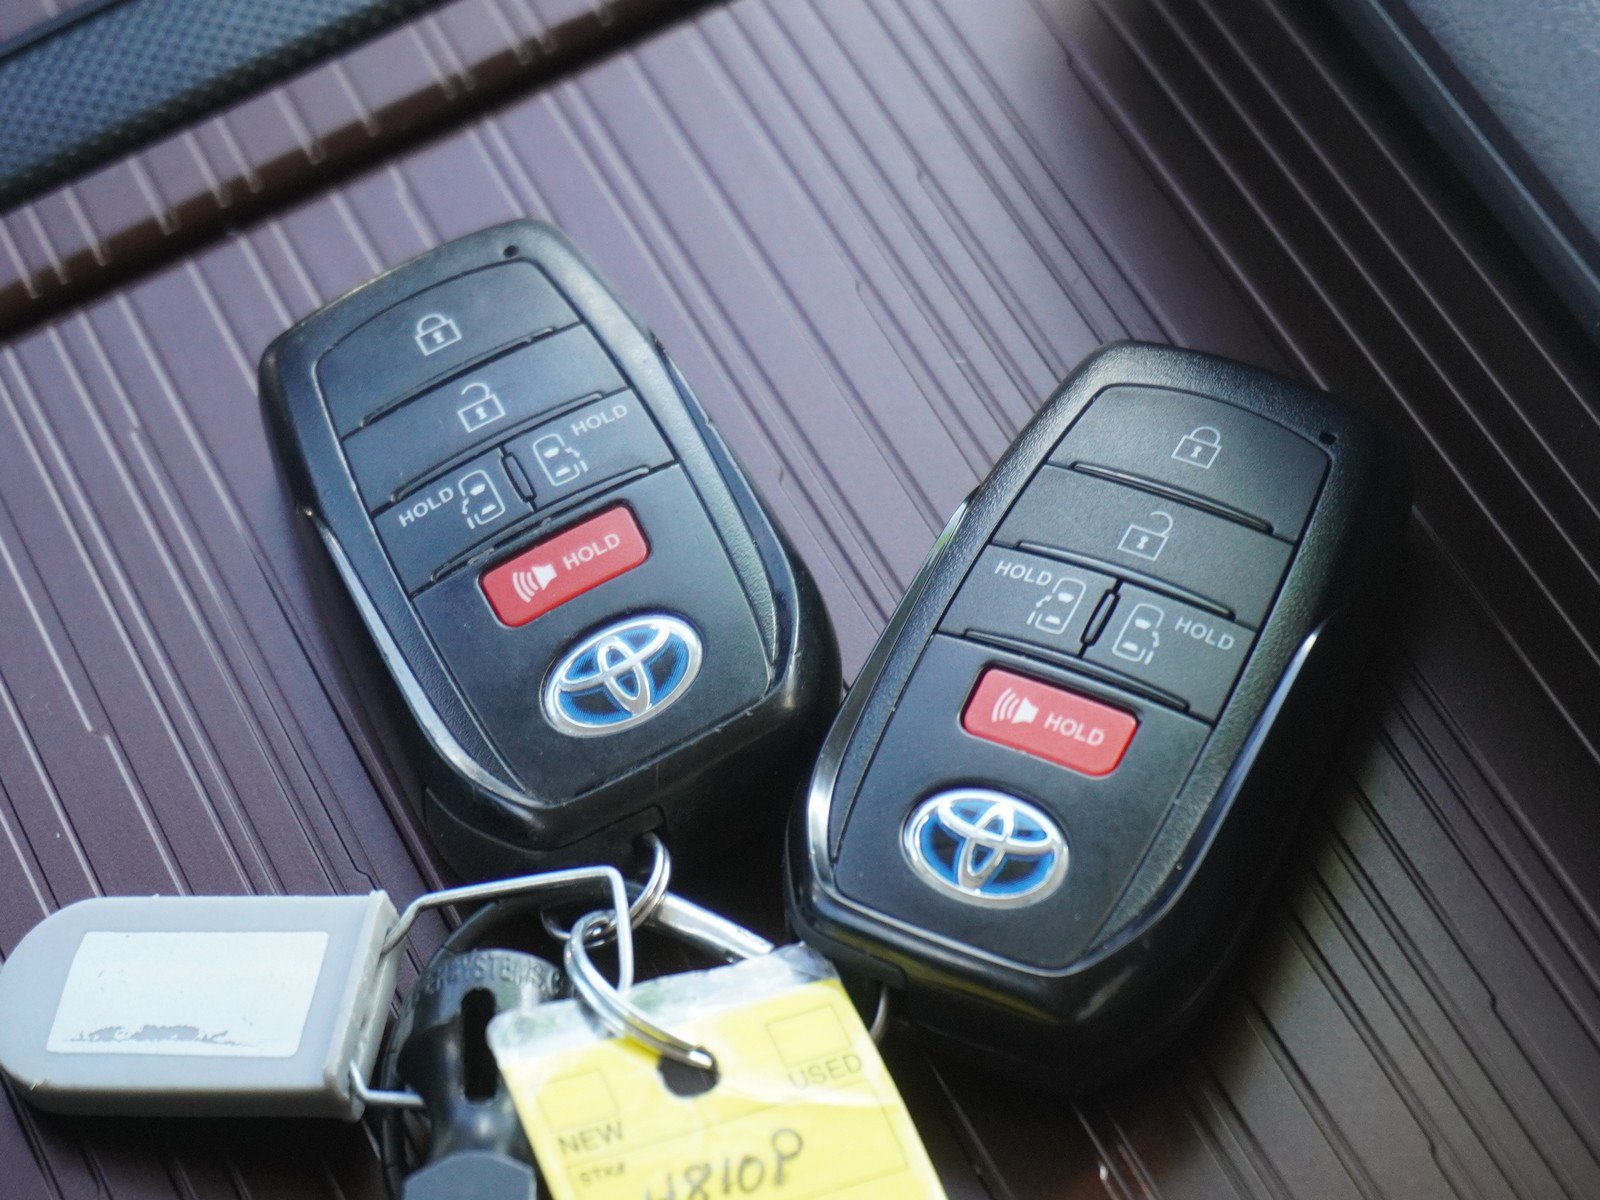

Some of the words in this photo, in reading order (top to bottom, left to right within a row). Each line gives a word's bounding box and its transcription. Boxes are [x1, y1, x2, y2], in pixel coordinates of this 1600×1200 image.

[571, 404, 628, 436] HOLD
[398, 486, 455, 528] HOLD
[562, 532, 621, 571] HOLD
[994, 559, 1052, 587] HOLD
[1174, 616, 1235, 651] HOLD
[1043, 713, 1105, 747] HOLD
[787, 1054, 863, 1091] USED
[557, 1121, 624, 1155] NEW
